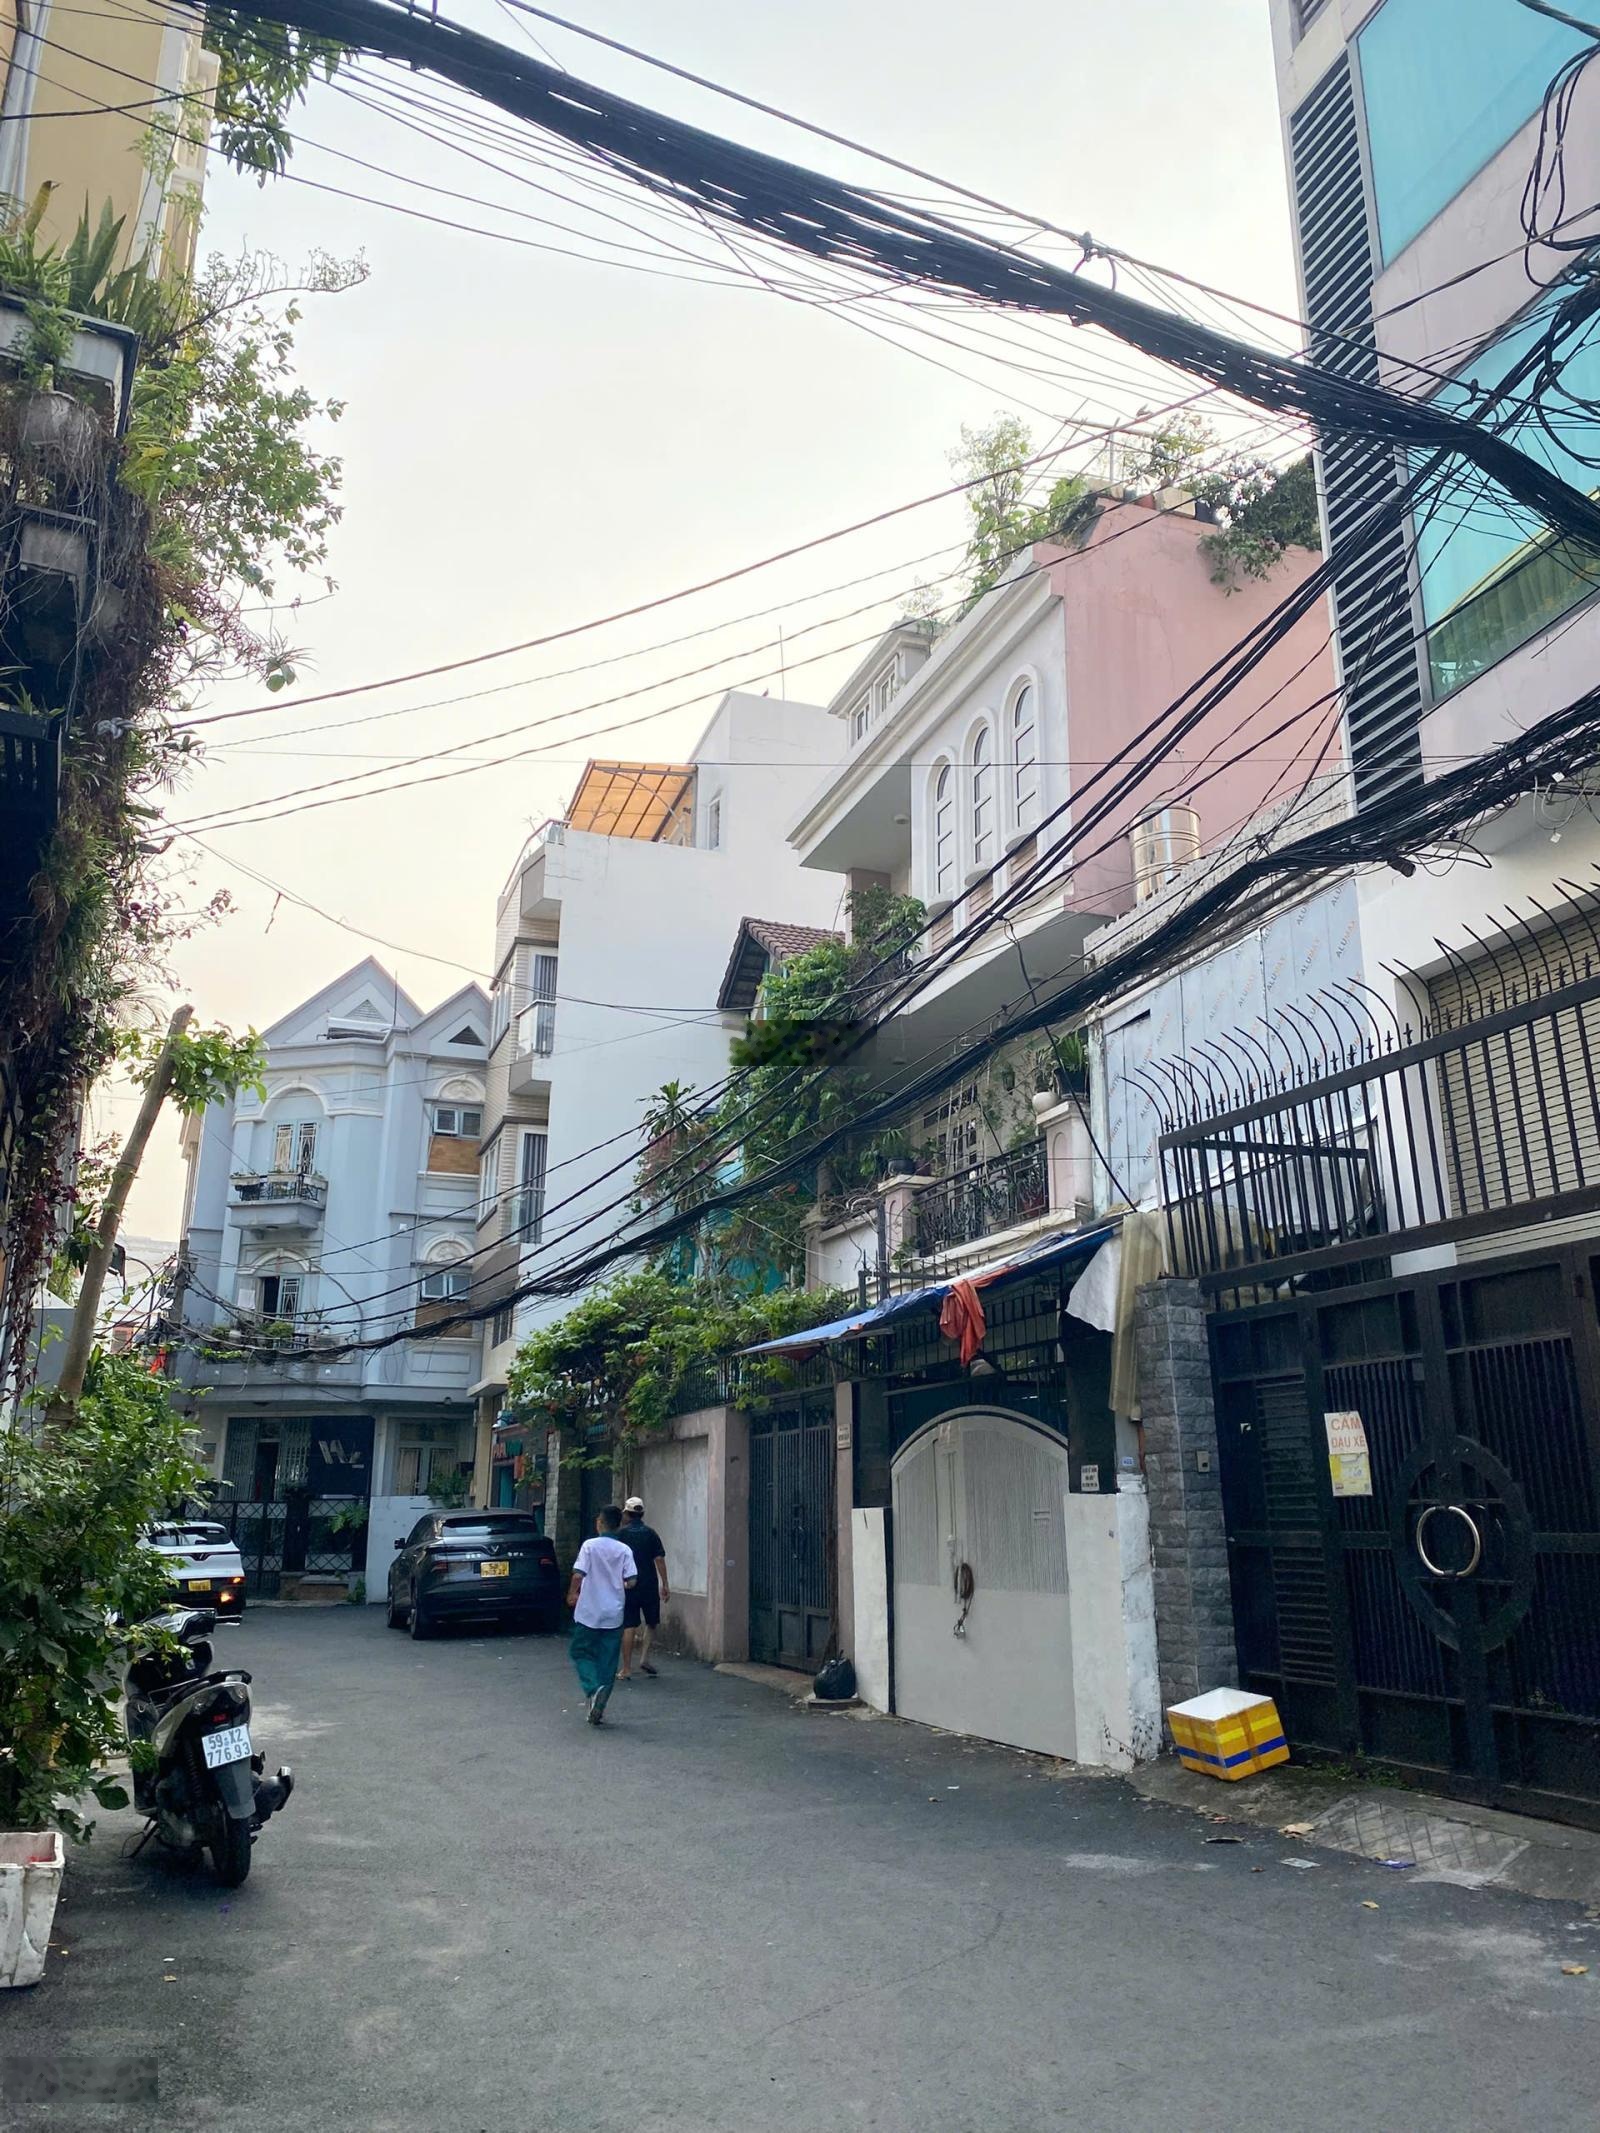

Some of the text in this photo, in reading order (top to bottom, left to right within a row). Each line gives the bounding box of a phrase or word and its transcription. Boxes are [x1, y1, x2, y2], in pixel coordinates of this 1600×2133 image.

[1301, 937, 1321, 976] ALUMAX
[1336, 919, 1357, 958] ALUMAX
[1266, 955, 1286, 992] ALUMAX
[207, 1742, 250, 1766] 776.93
